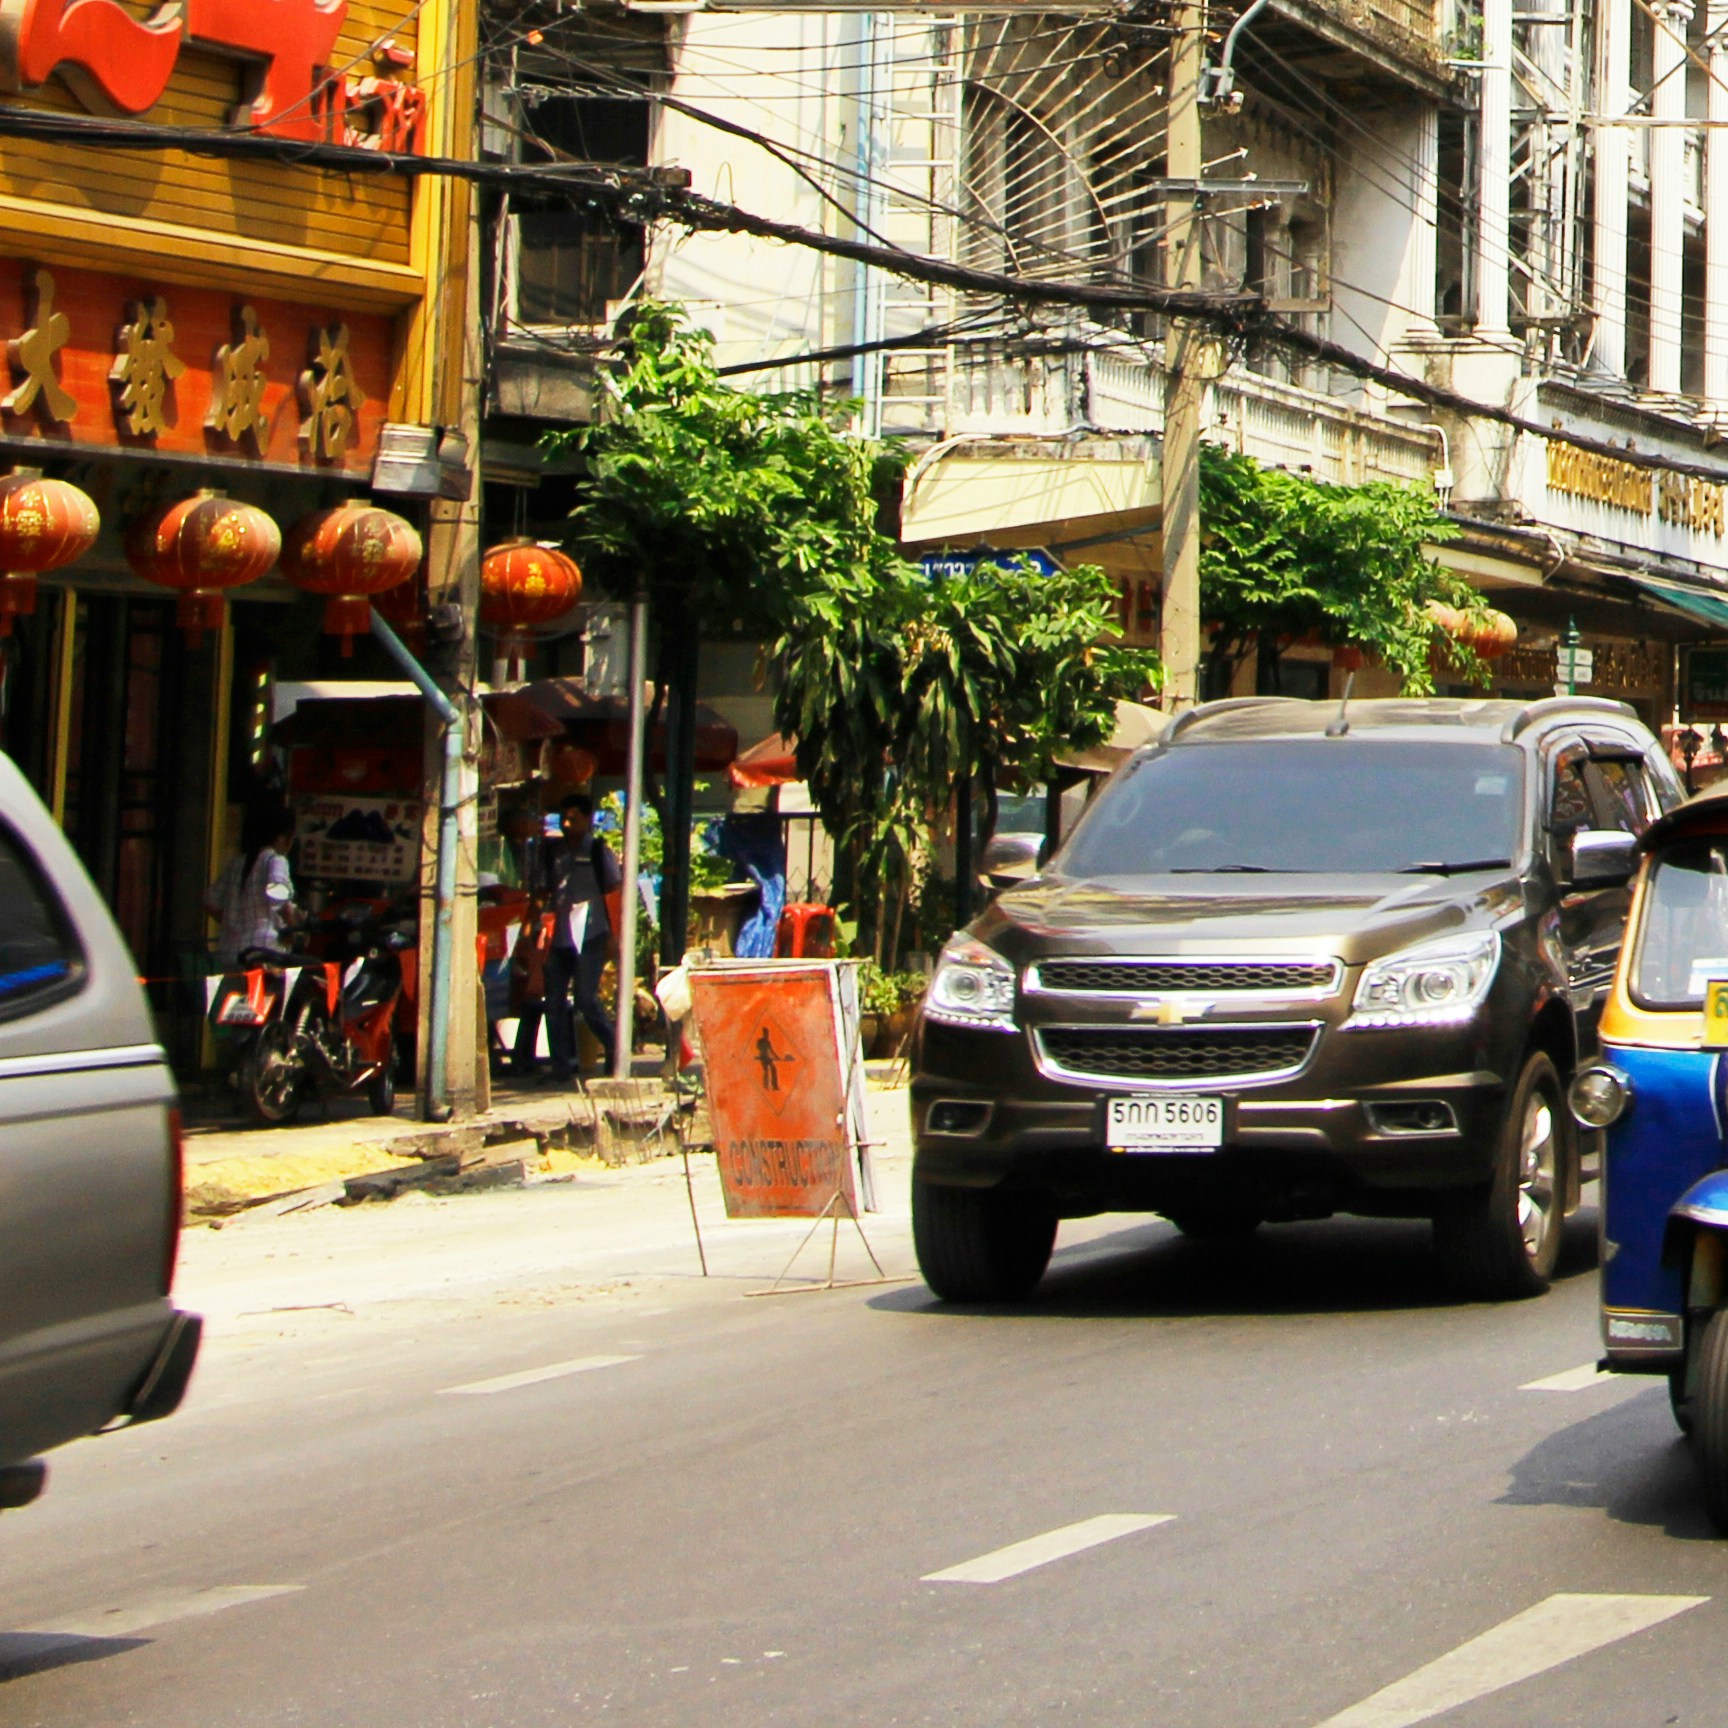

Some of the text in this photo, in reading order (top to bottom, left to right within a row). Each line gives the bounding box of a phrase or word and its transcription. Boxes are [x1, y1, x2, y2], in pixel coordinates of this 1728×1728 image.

[1114, 1102, 1218, 1123] 5กก 5606
[728, 1137, 846, 1189] CONSTRUCTION
